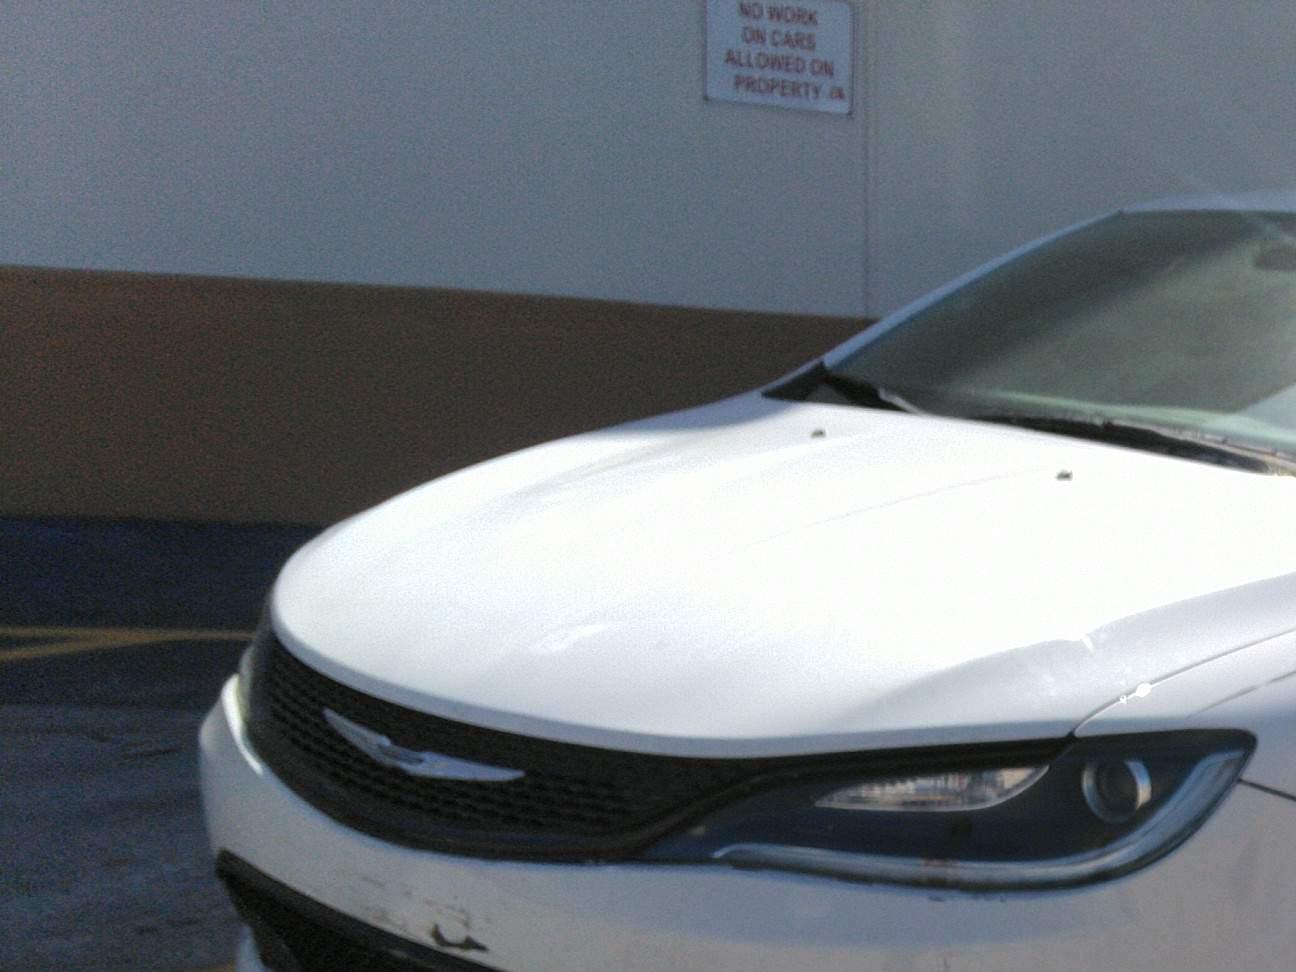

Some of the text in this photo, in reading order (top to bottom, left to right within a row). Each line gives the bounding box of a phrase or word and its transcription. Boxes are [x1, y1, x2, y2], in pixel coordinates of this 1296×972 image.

[739, 2, 818, 26] NO WORK
[742, 26, 816, 51] ON CARS
[725, 48, 834, 79] ALLOWED ON
[734, 74, 822, 99] PROPERTY
